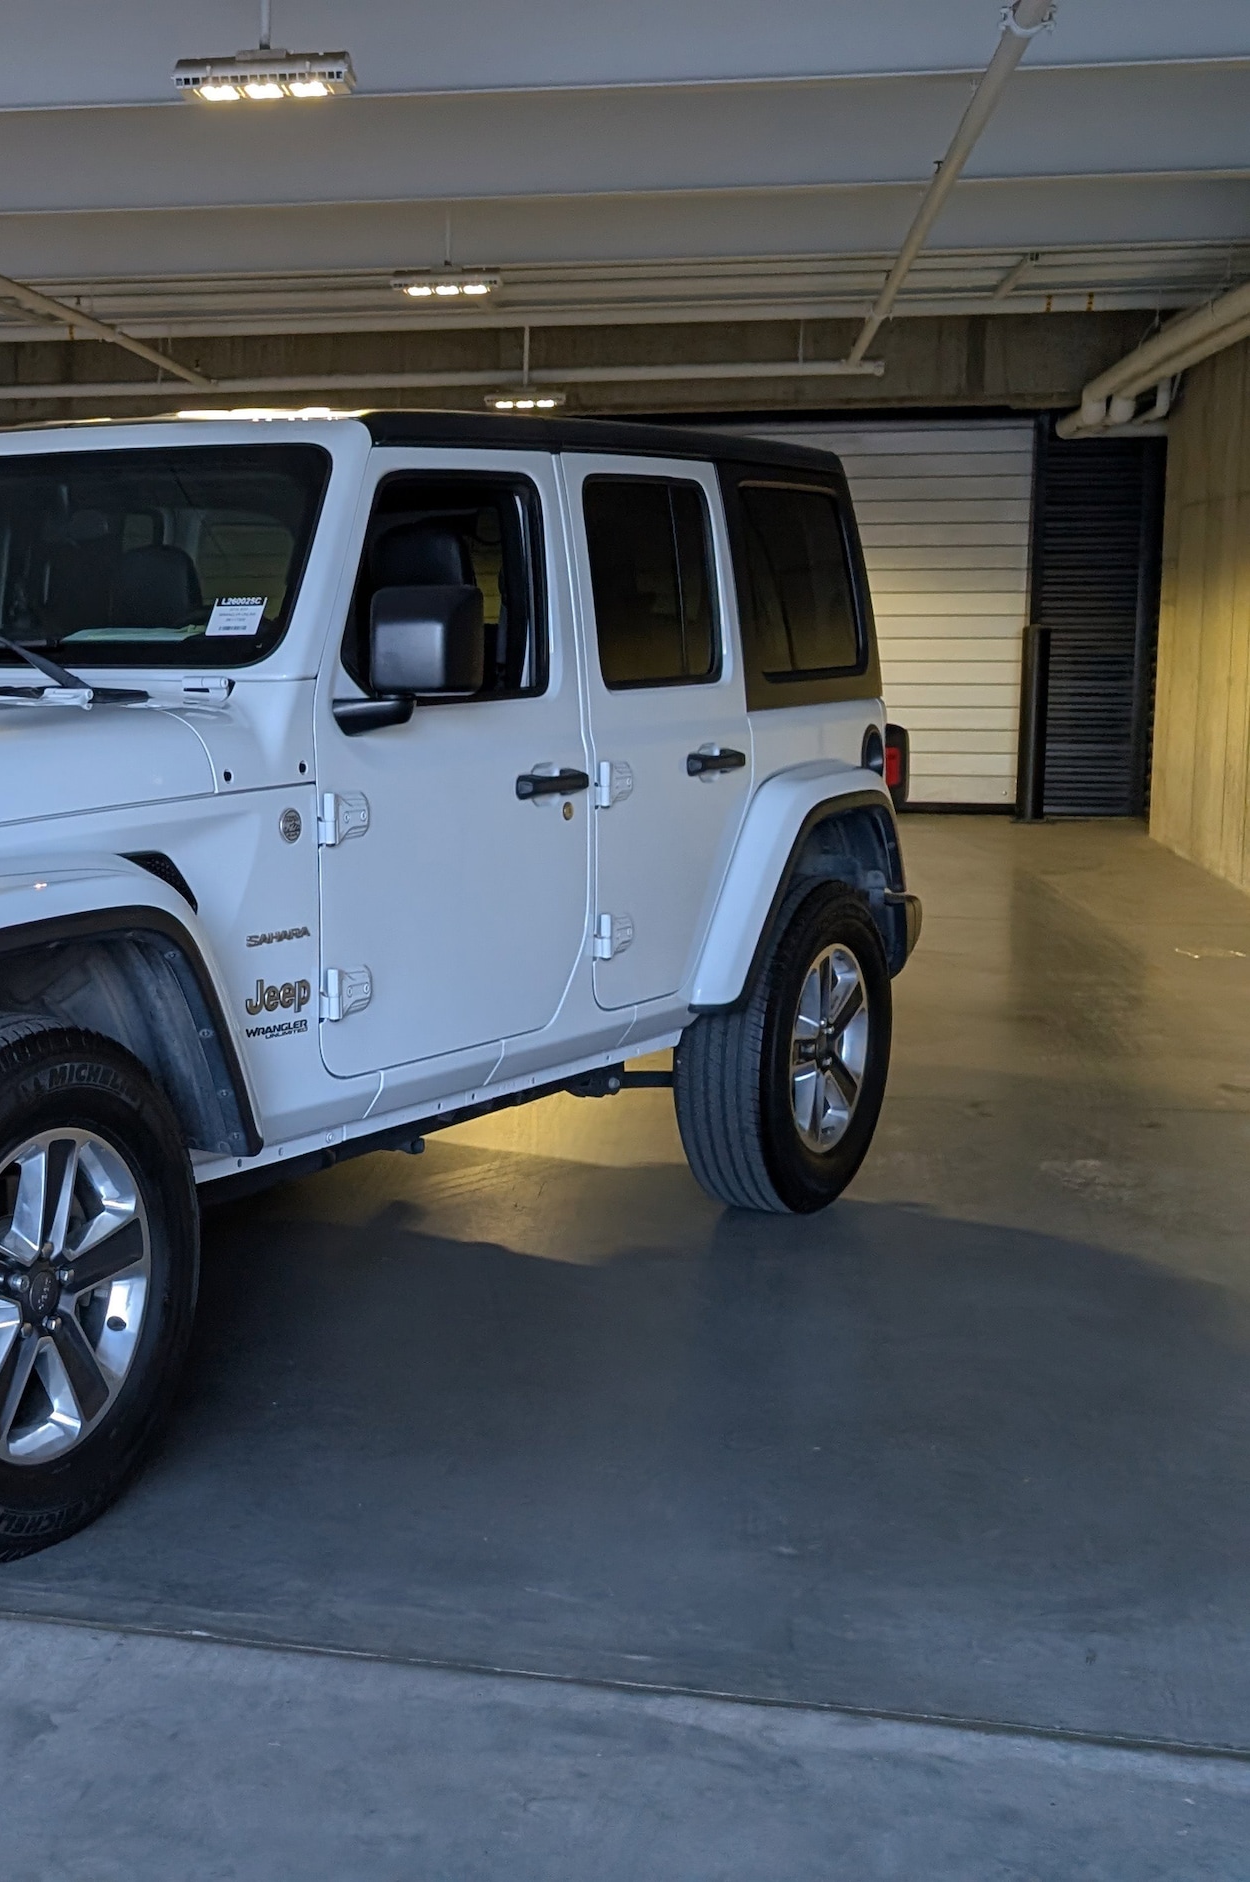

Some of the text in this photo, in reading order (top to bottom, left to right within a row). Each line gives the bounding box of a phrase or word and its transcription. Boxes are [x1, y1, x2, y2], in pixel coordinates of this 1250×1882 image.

[246, 926, 311, 948] SAHARA
[245, 978, 311, 1016] Jeep
[245, 1018, 308, 1038] WRANGLER
